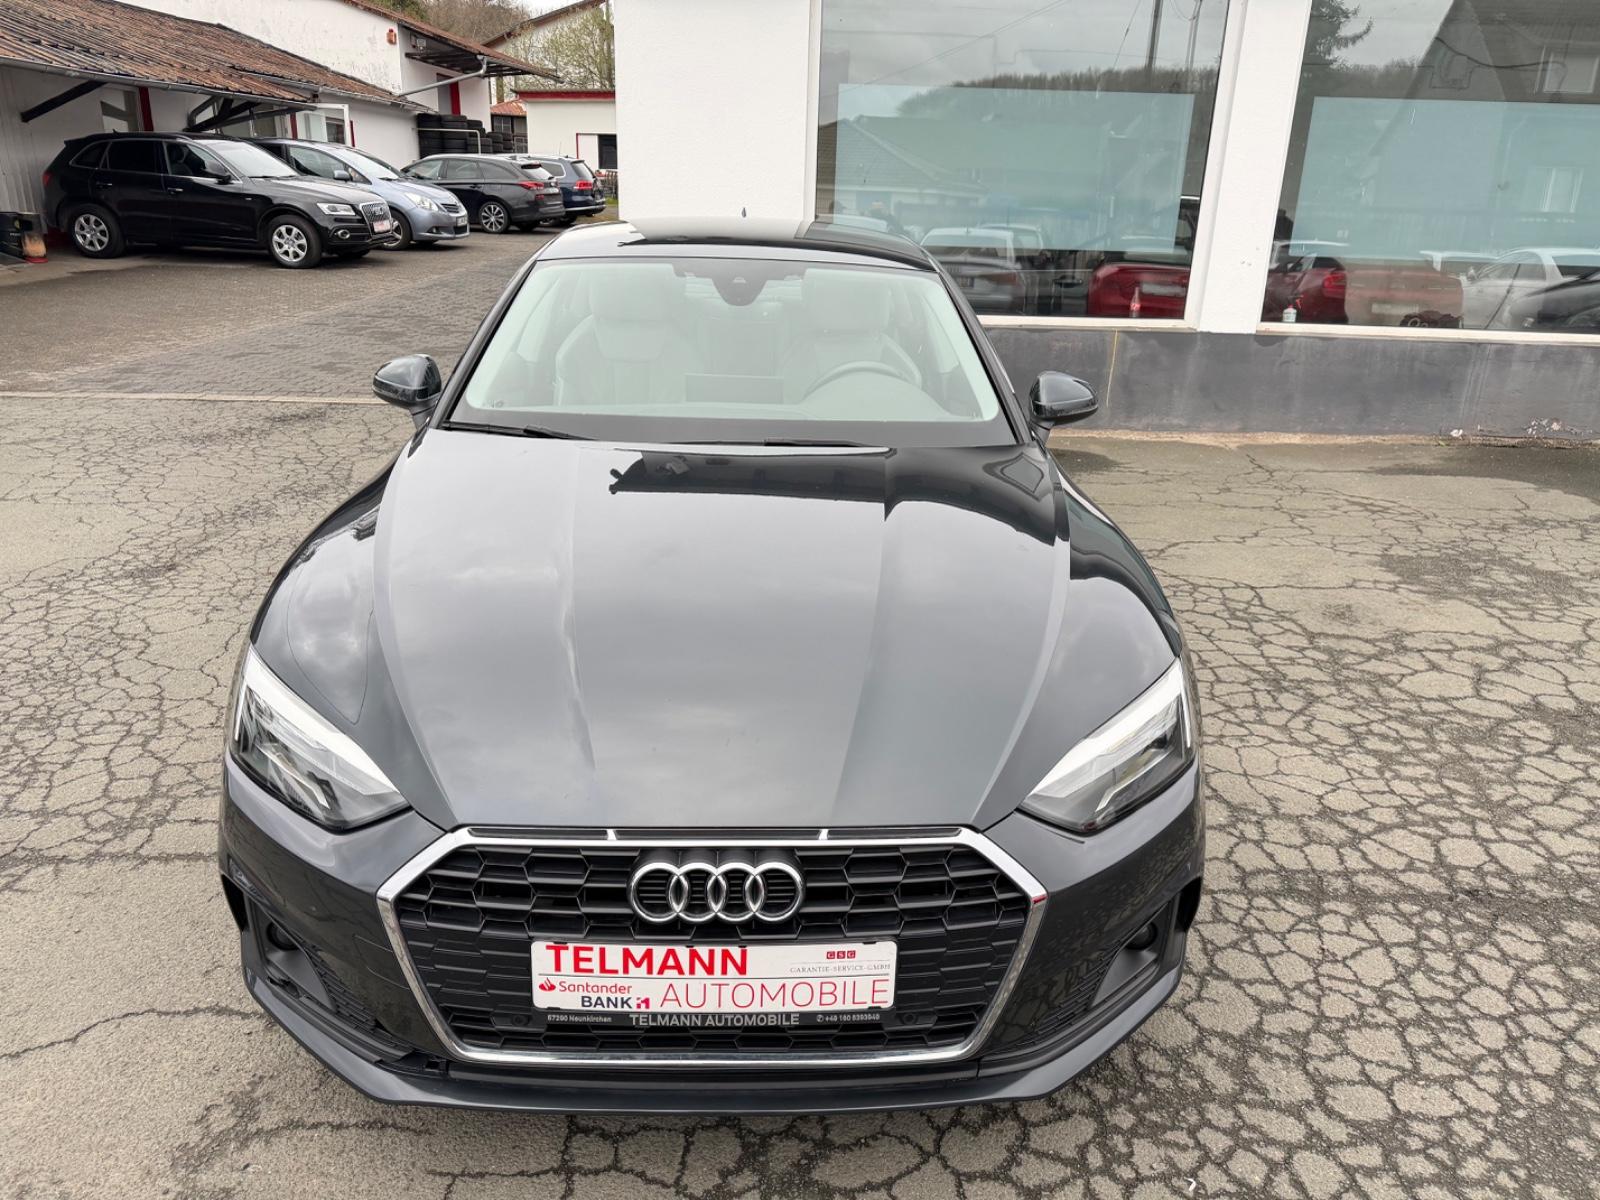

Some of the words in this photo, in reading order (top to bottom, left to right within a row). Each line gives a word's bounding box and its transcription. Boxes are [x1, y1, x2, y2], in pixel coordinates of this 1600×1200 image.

[546, 944, 748, 976] TELMANN
[559, 981, 632, 994] Santander
[659, 978, 889, 1009] AUTOMOBILE
[629, 1013, 702, 1026] TELMANN
[704, 1013, 800, 1026] AUTOMOBILE
